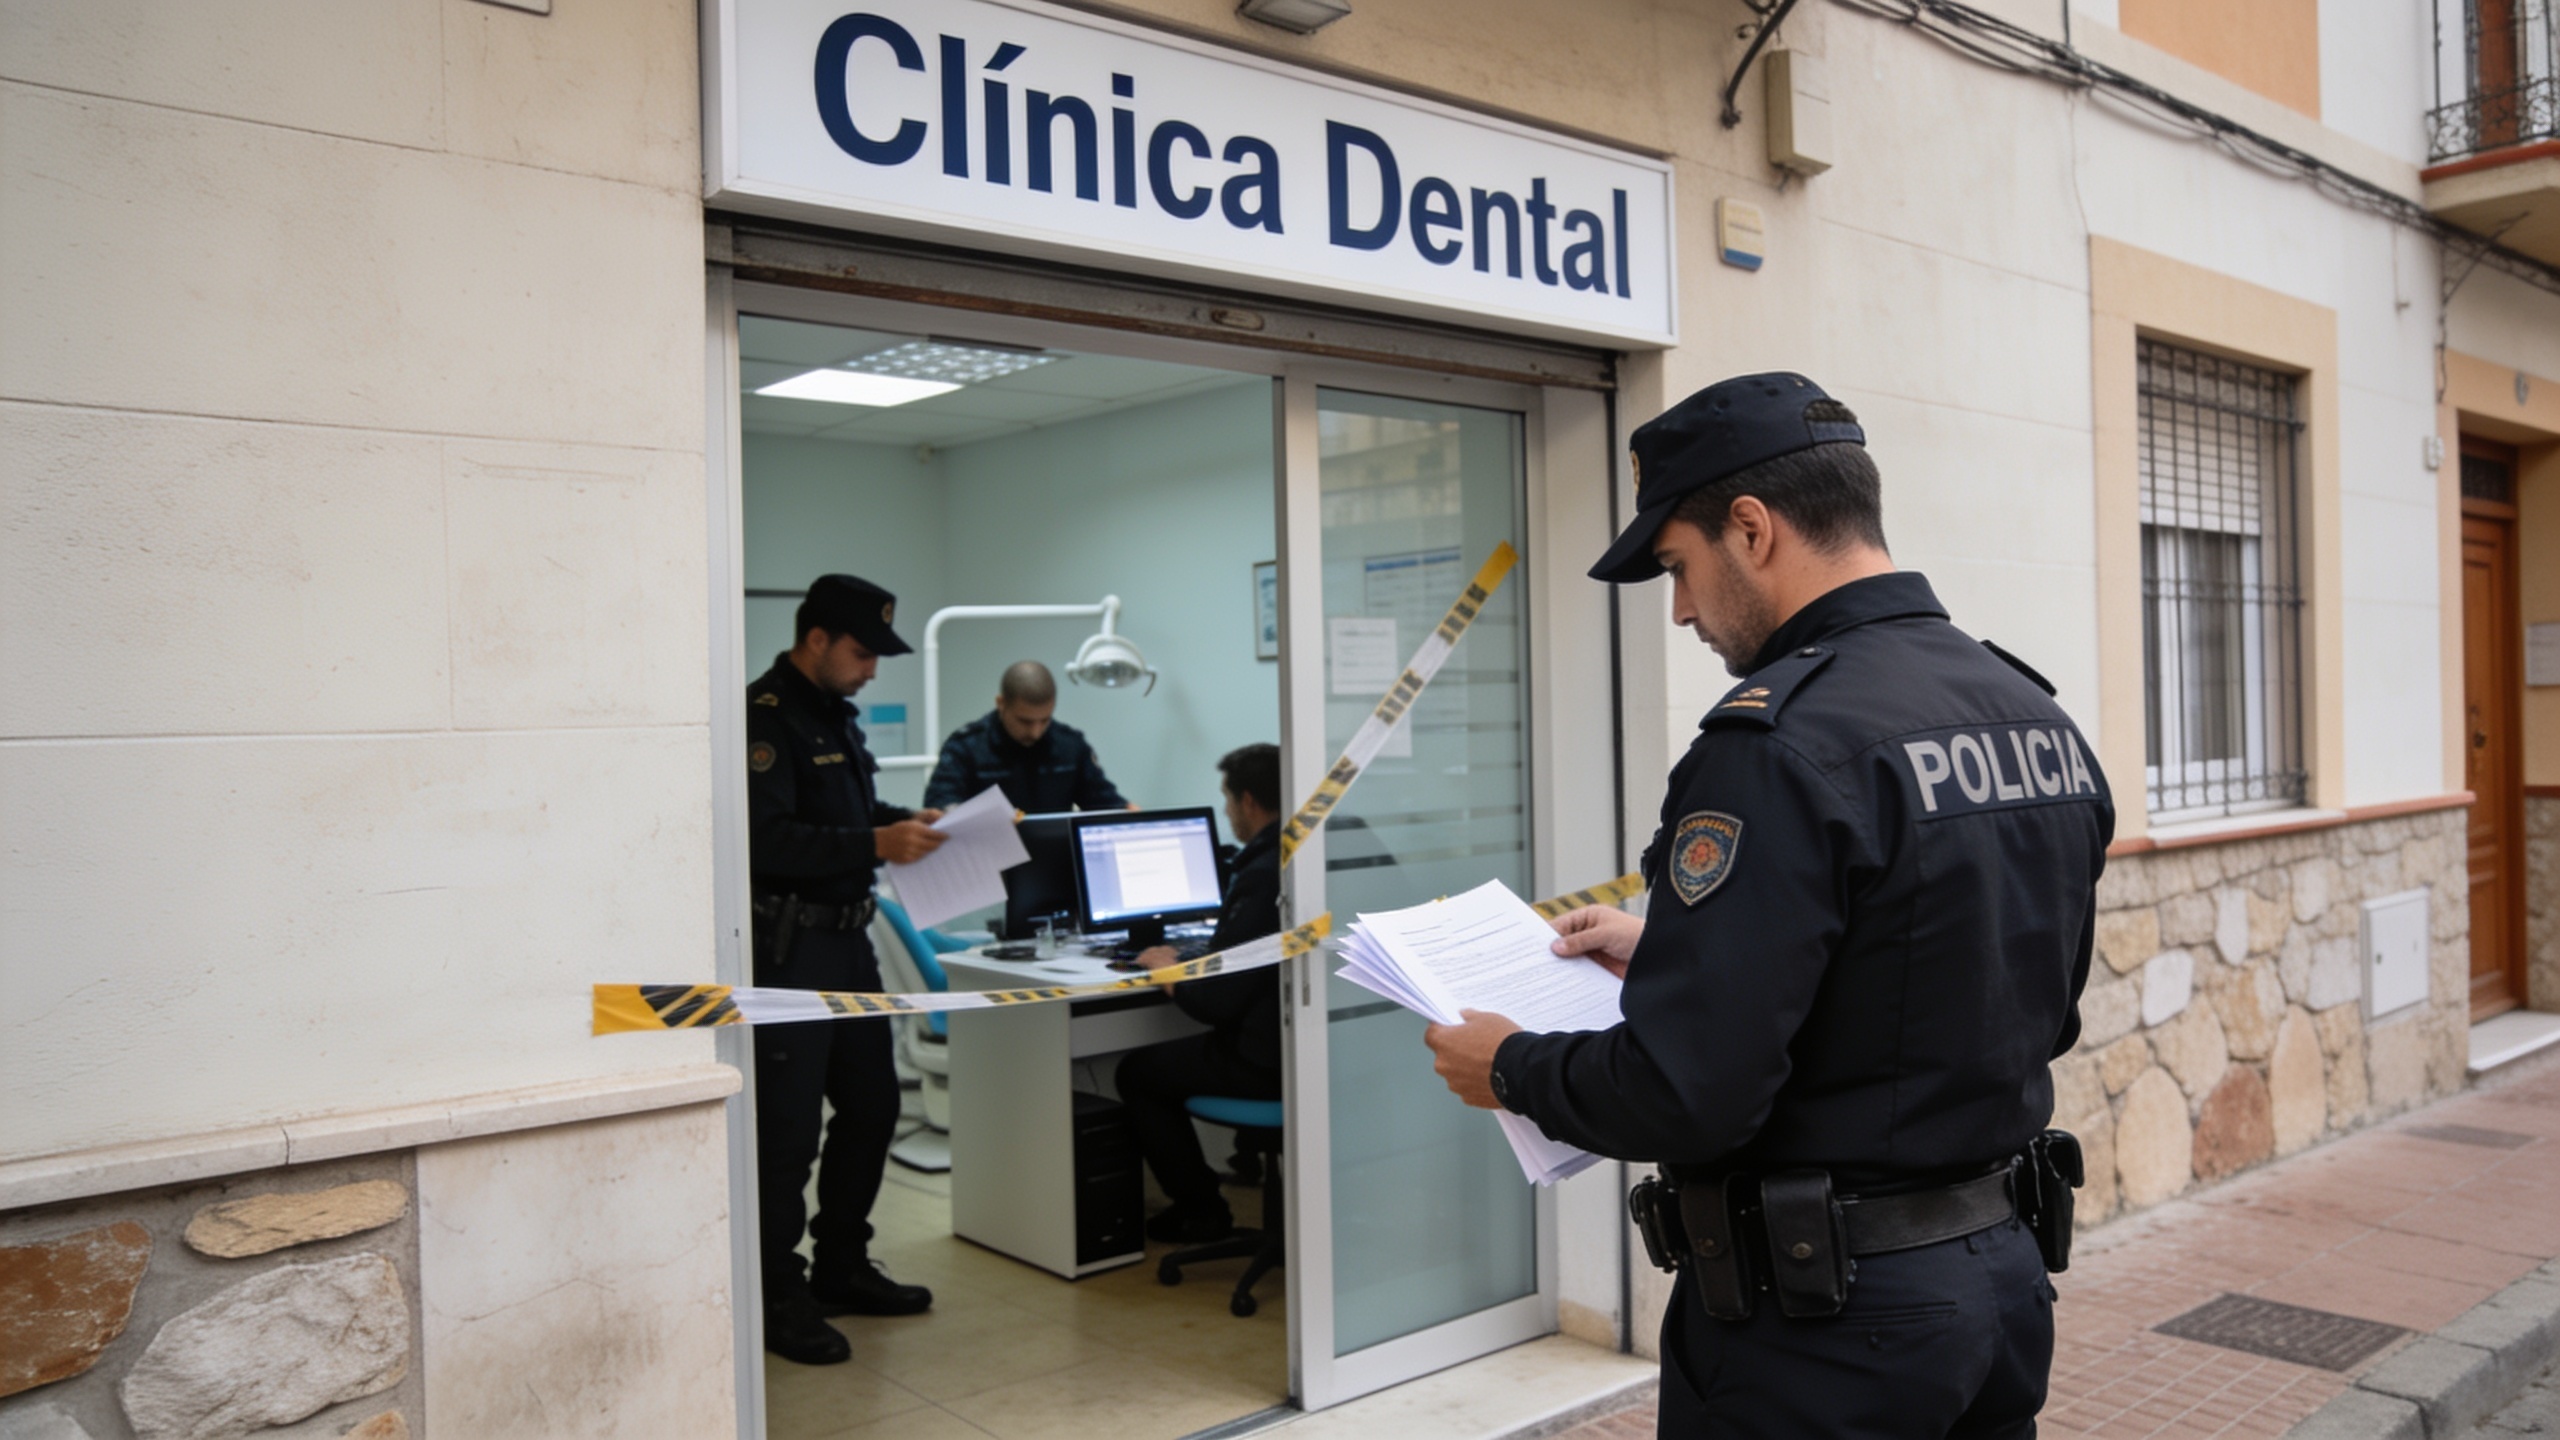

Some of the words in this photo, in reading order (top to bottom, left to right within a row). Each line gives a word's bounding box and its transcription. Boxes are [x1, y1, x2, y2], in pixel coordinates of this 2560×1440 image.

[813, 12, 1284, 235] Clínica
[1326, 120, 1632, 299] Dental
[1903, 728, 2097, 812] POLICIA
